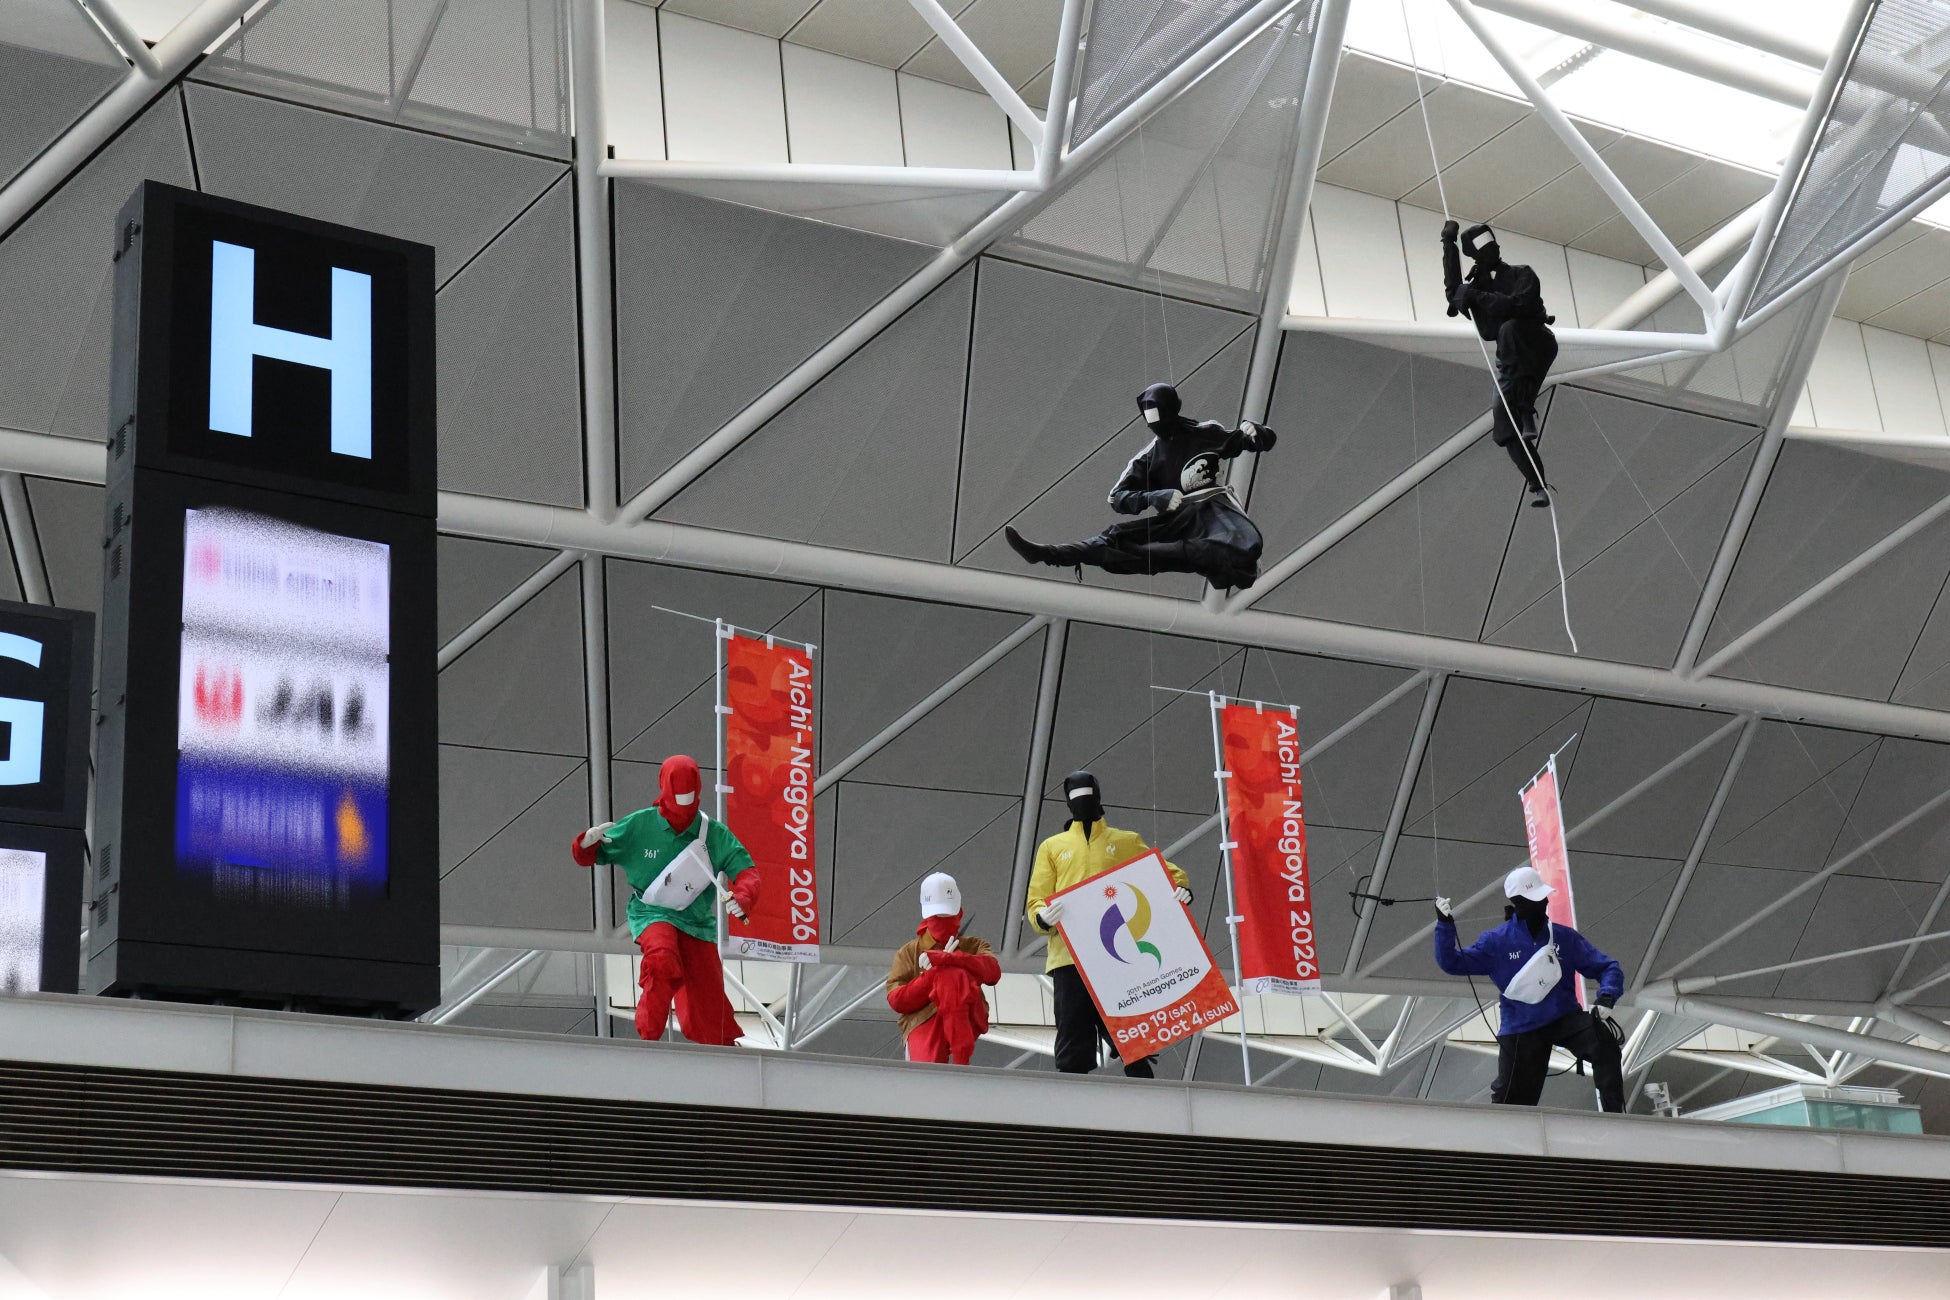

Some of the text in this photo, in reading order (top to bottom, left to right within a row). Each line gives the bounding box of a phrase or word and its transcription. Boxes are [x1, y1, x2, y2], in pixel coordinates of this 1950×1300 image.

[209, 239, 372, 460] H
[783, 658, 816, 941] Aichi-Nagoya 2026
[1277, 720, 1305, 902] Aichi-Nagoya
[1290, 910, 1317, 978] 2026
[1118, 966, 1200, 1010] Aichi-Nagoya 2026
[1126, 966, 1182, 995] 20th Asian Games
[1116, 1000, 1197, 1044] Sep 19 (SAT)
[1192, 1012, 1203, 1026] 4
[1203, 1001, 1234, 1022] (SUN)
